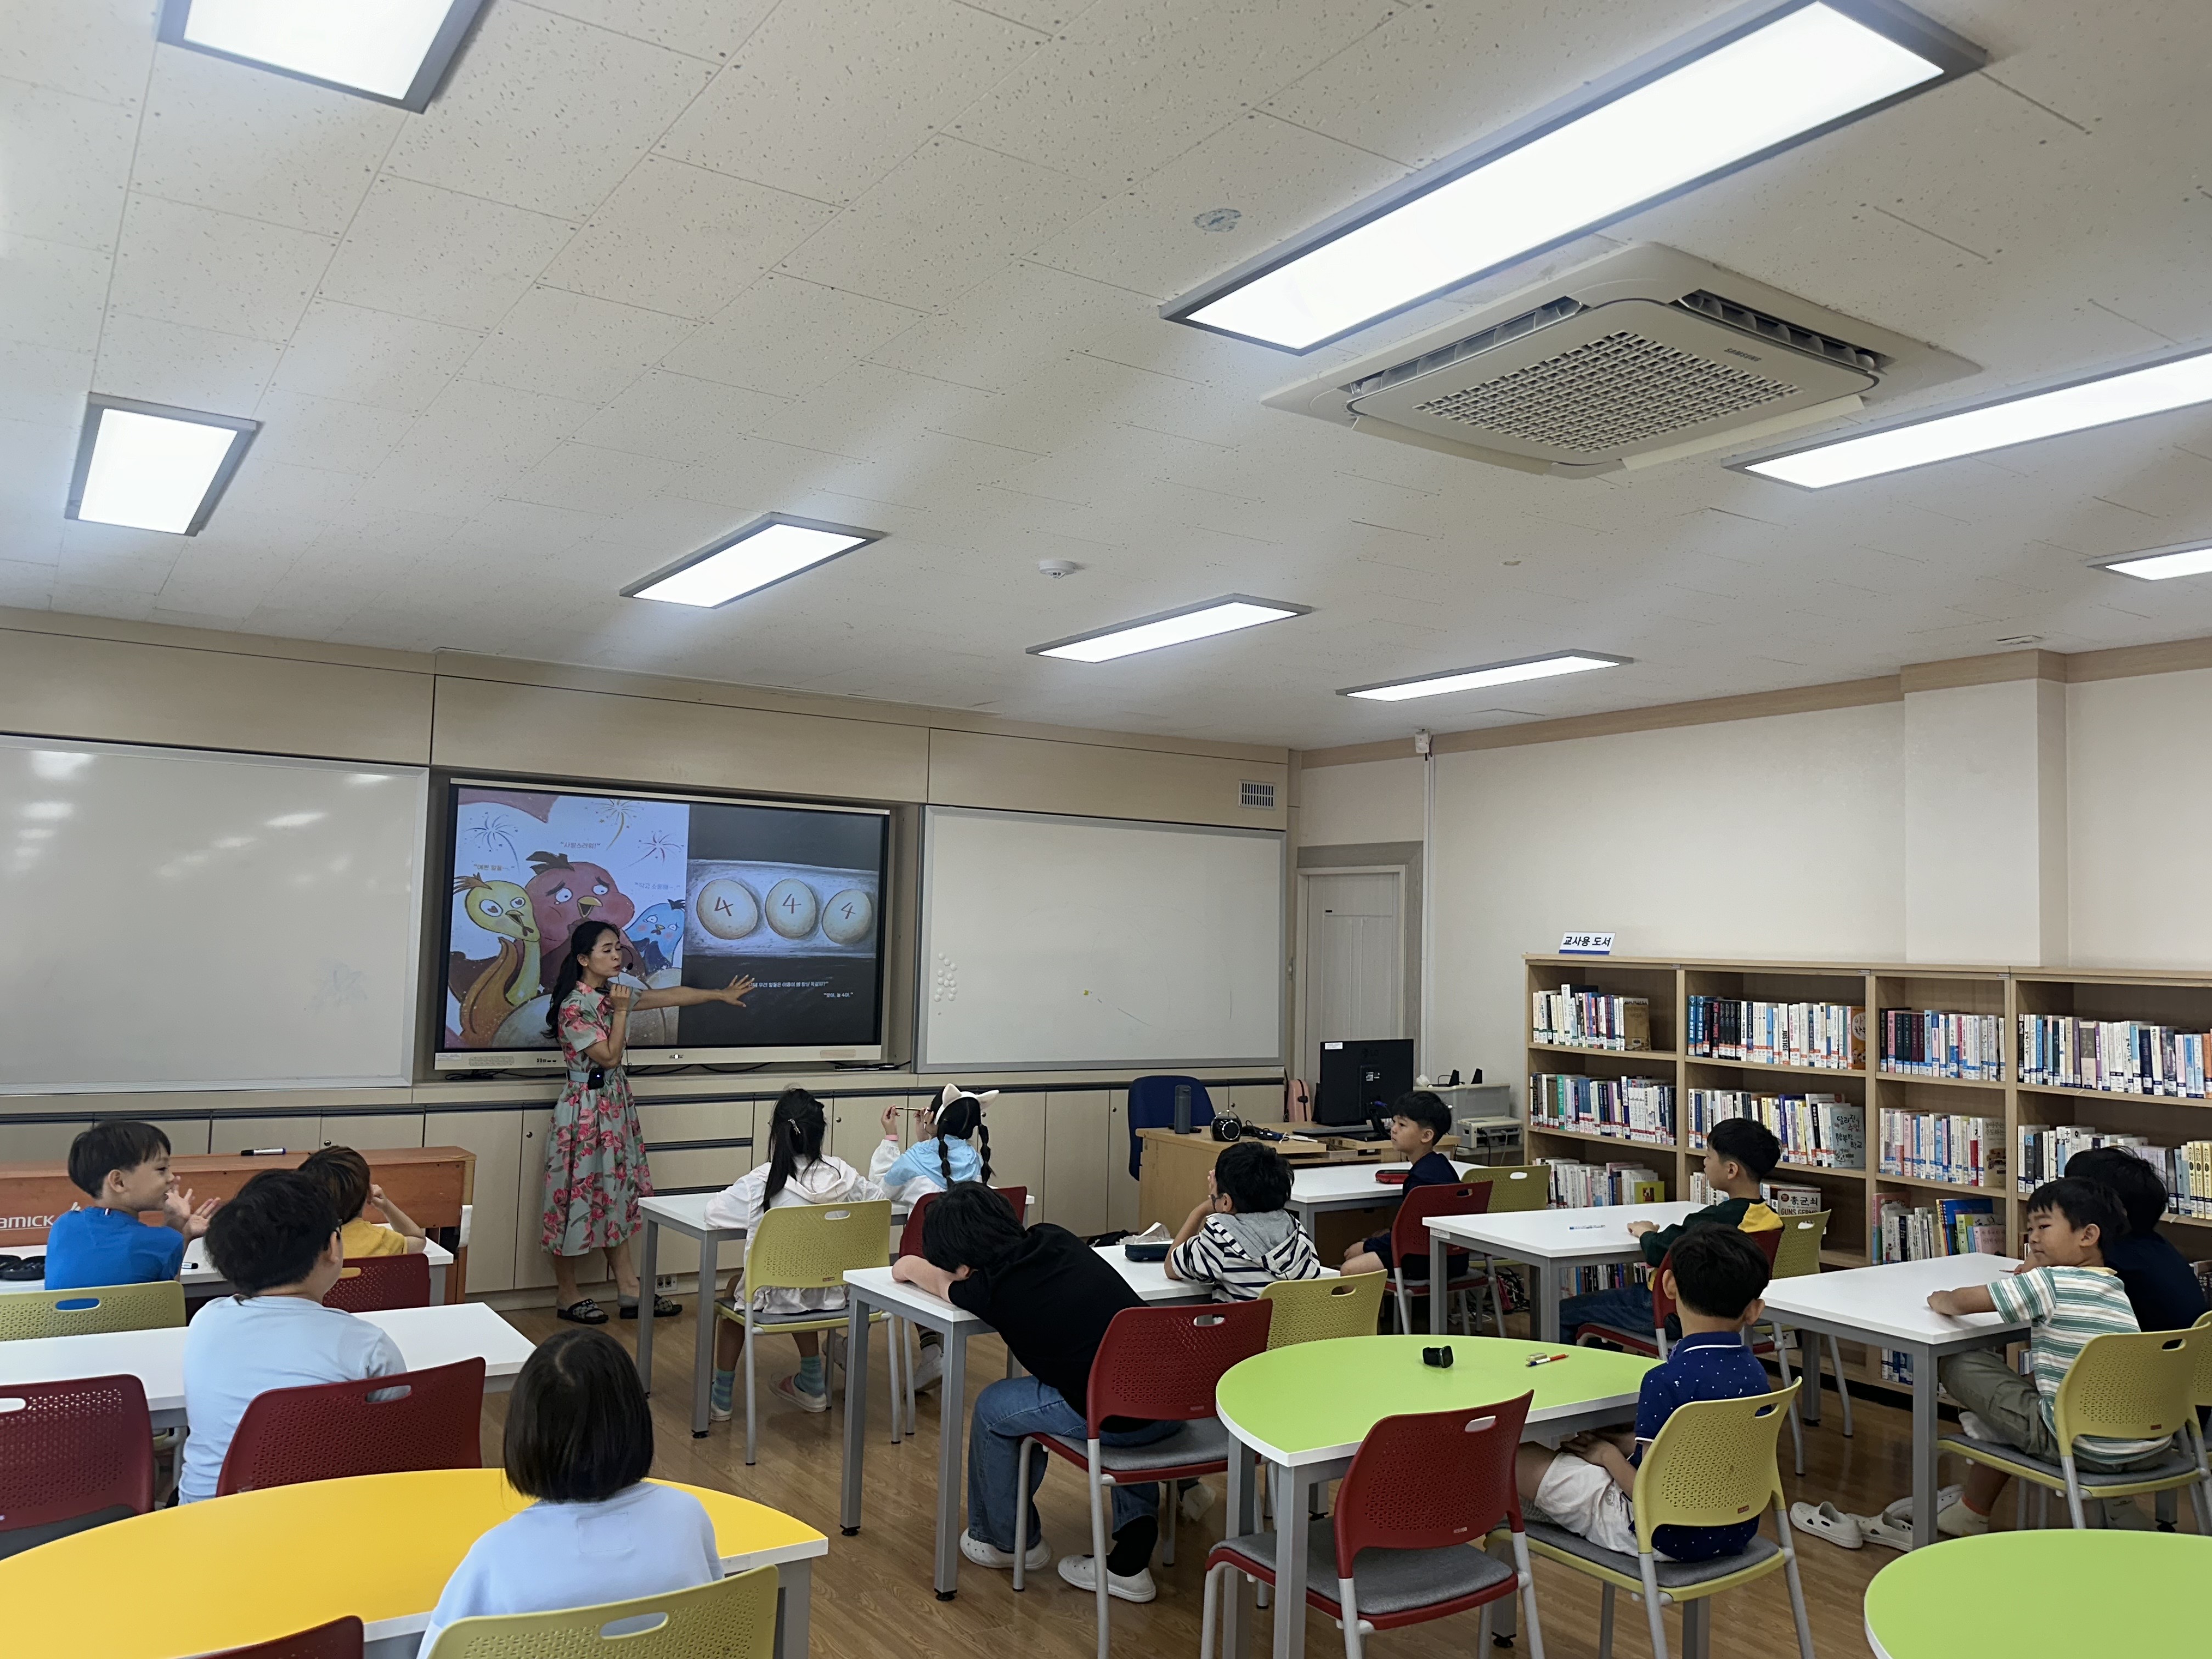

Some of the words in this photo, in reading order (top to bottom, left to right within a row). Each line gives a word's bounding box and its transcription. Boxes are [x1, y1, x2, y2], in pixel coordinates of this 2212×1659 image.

[1724, 347, 1762, 362] SAMSUNG
[714, 896, 734, 917] 4
[782, 893, 802, 914] 4
[840, 902, 856, 919] 4
[1563, 936, 1590, 946] 교사용
[1592, 937, 1611, 947] 도서
[1810, 1197, 1818, 1205] 쇠
